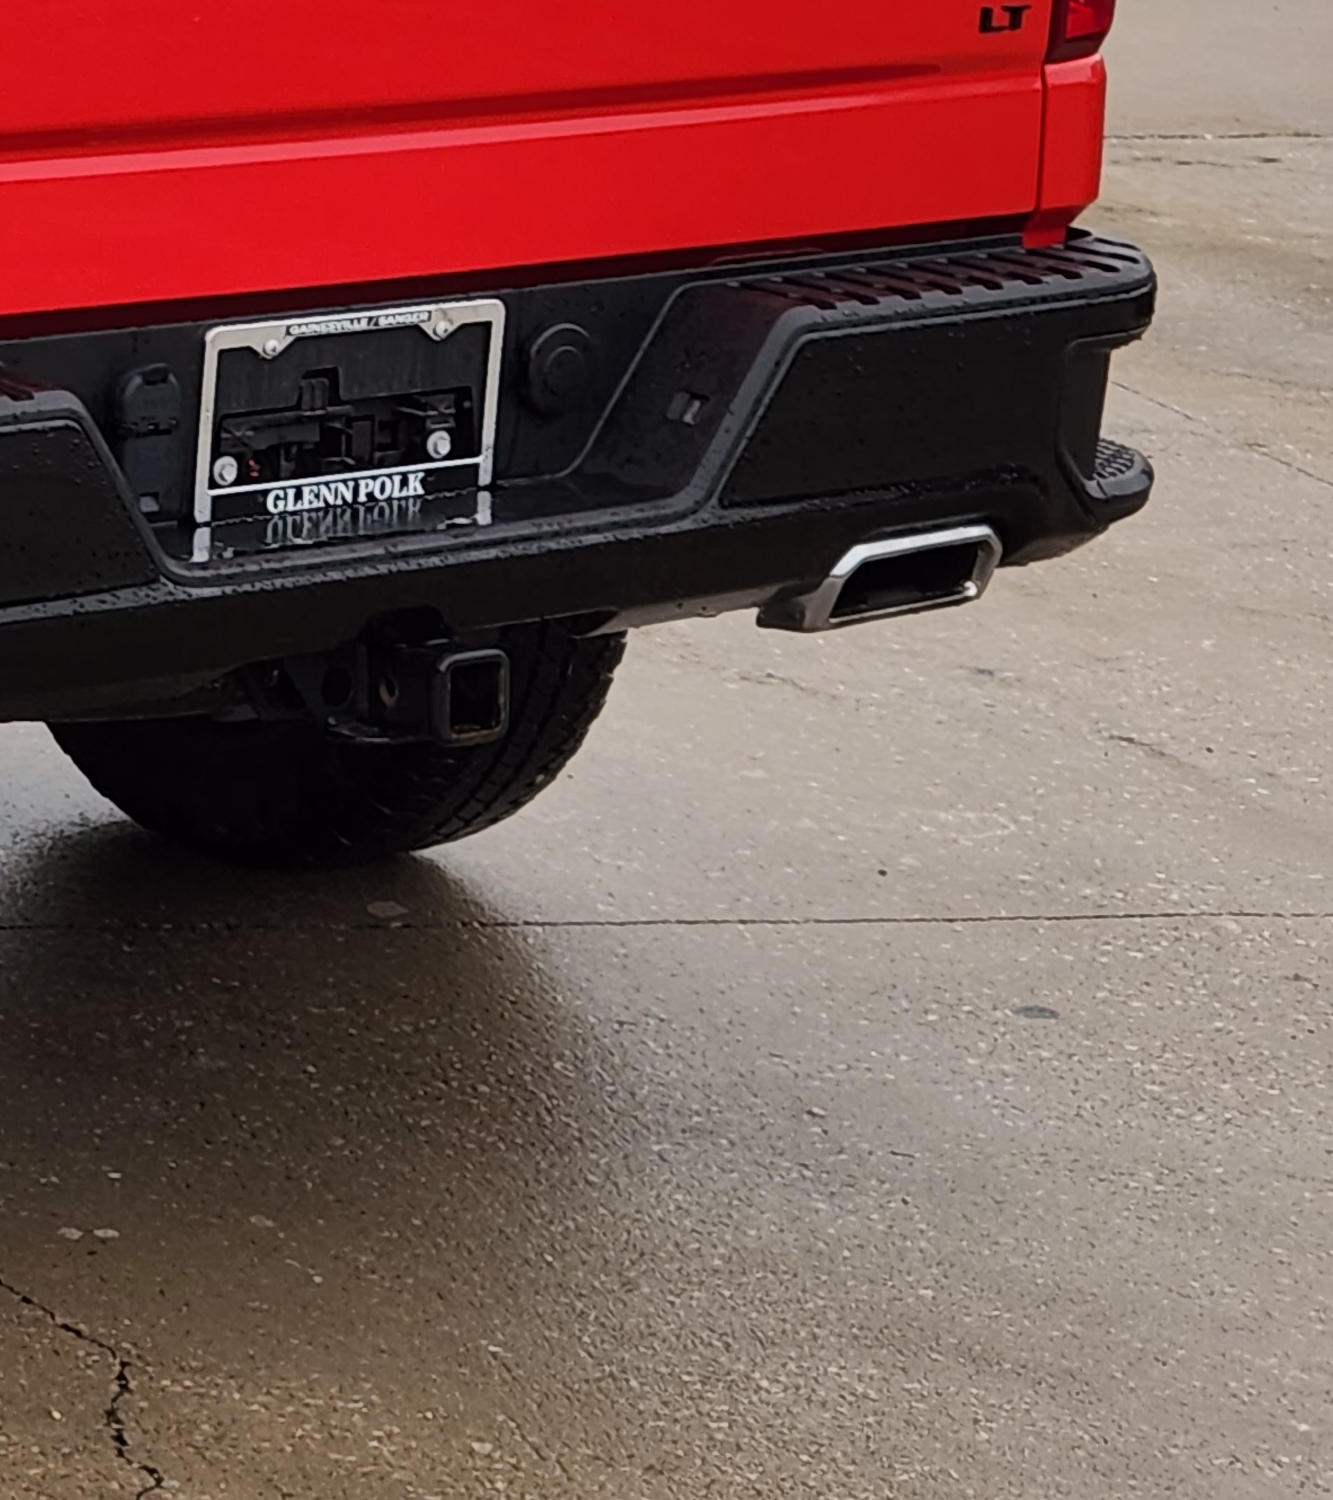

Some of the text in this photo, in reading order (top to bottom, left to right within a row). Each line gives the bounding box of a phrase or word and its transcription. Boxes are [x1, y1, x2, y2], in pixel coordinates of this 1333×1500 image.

[978, 4, 1032, 34] LT
[266, 471, 426, 514] GLENN POLK
